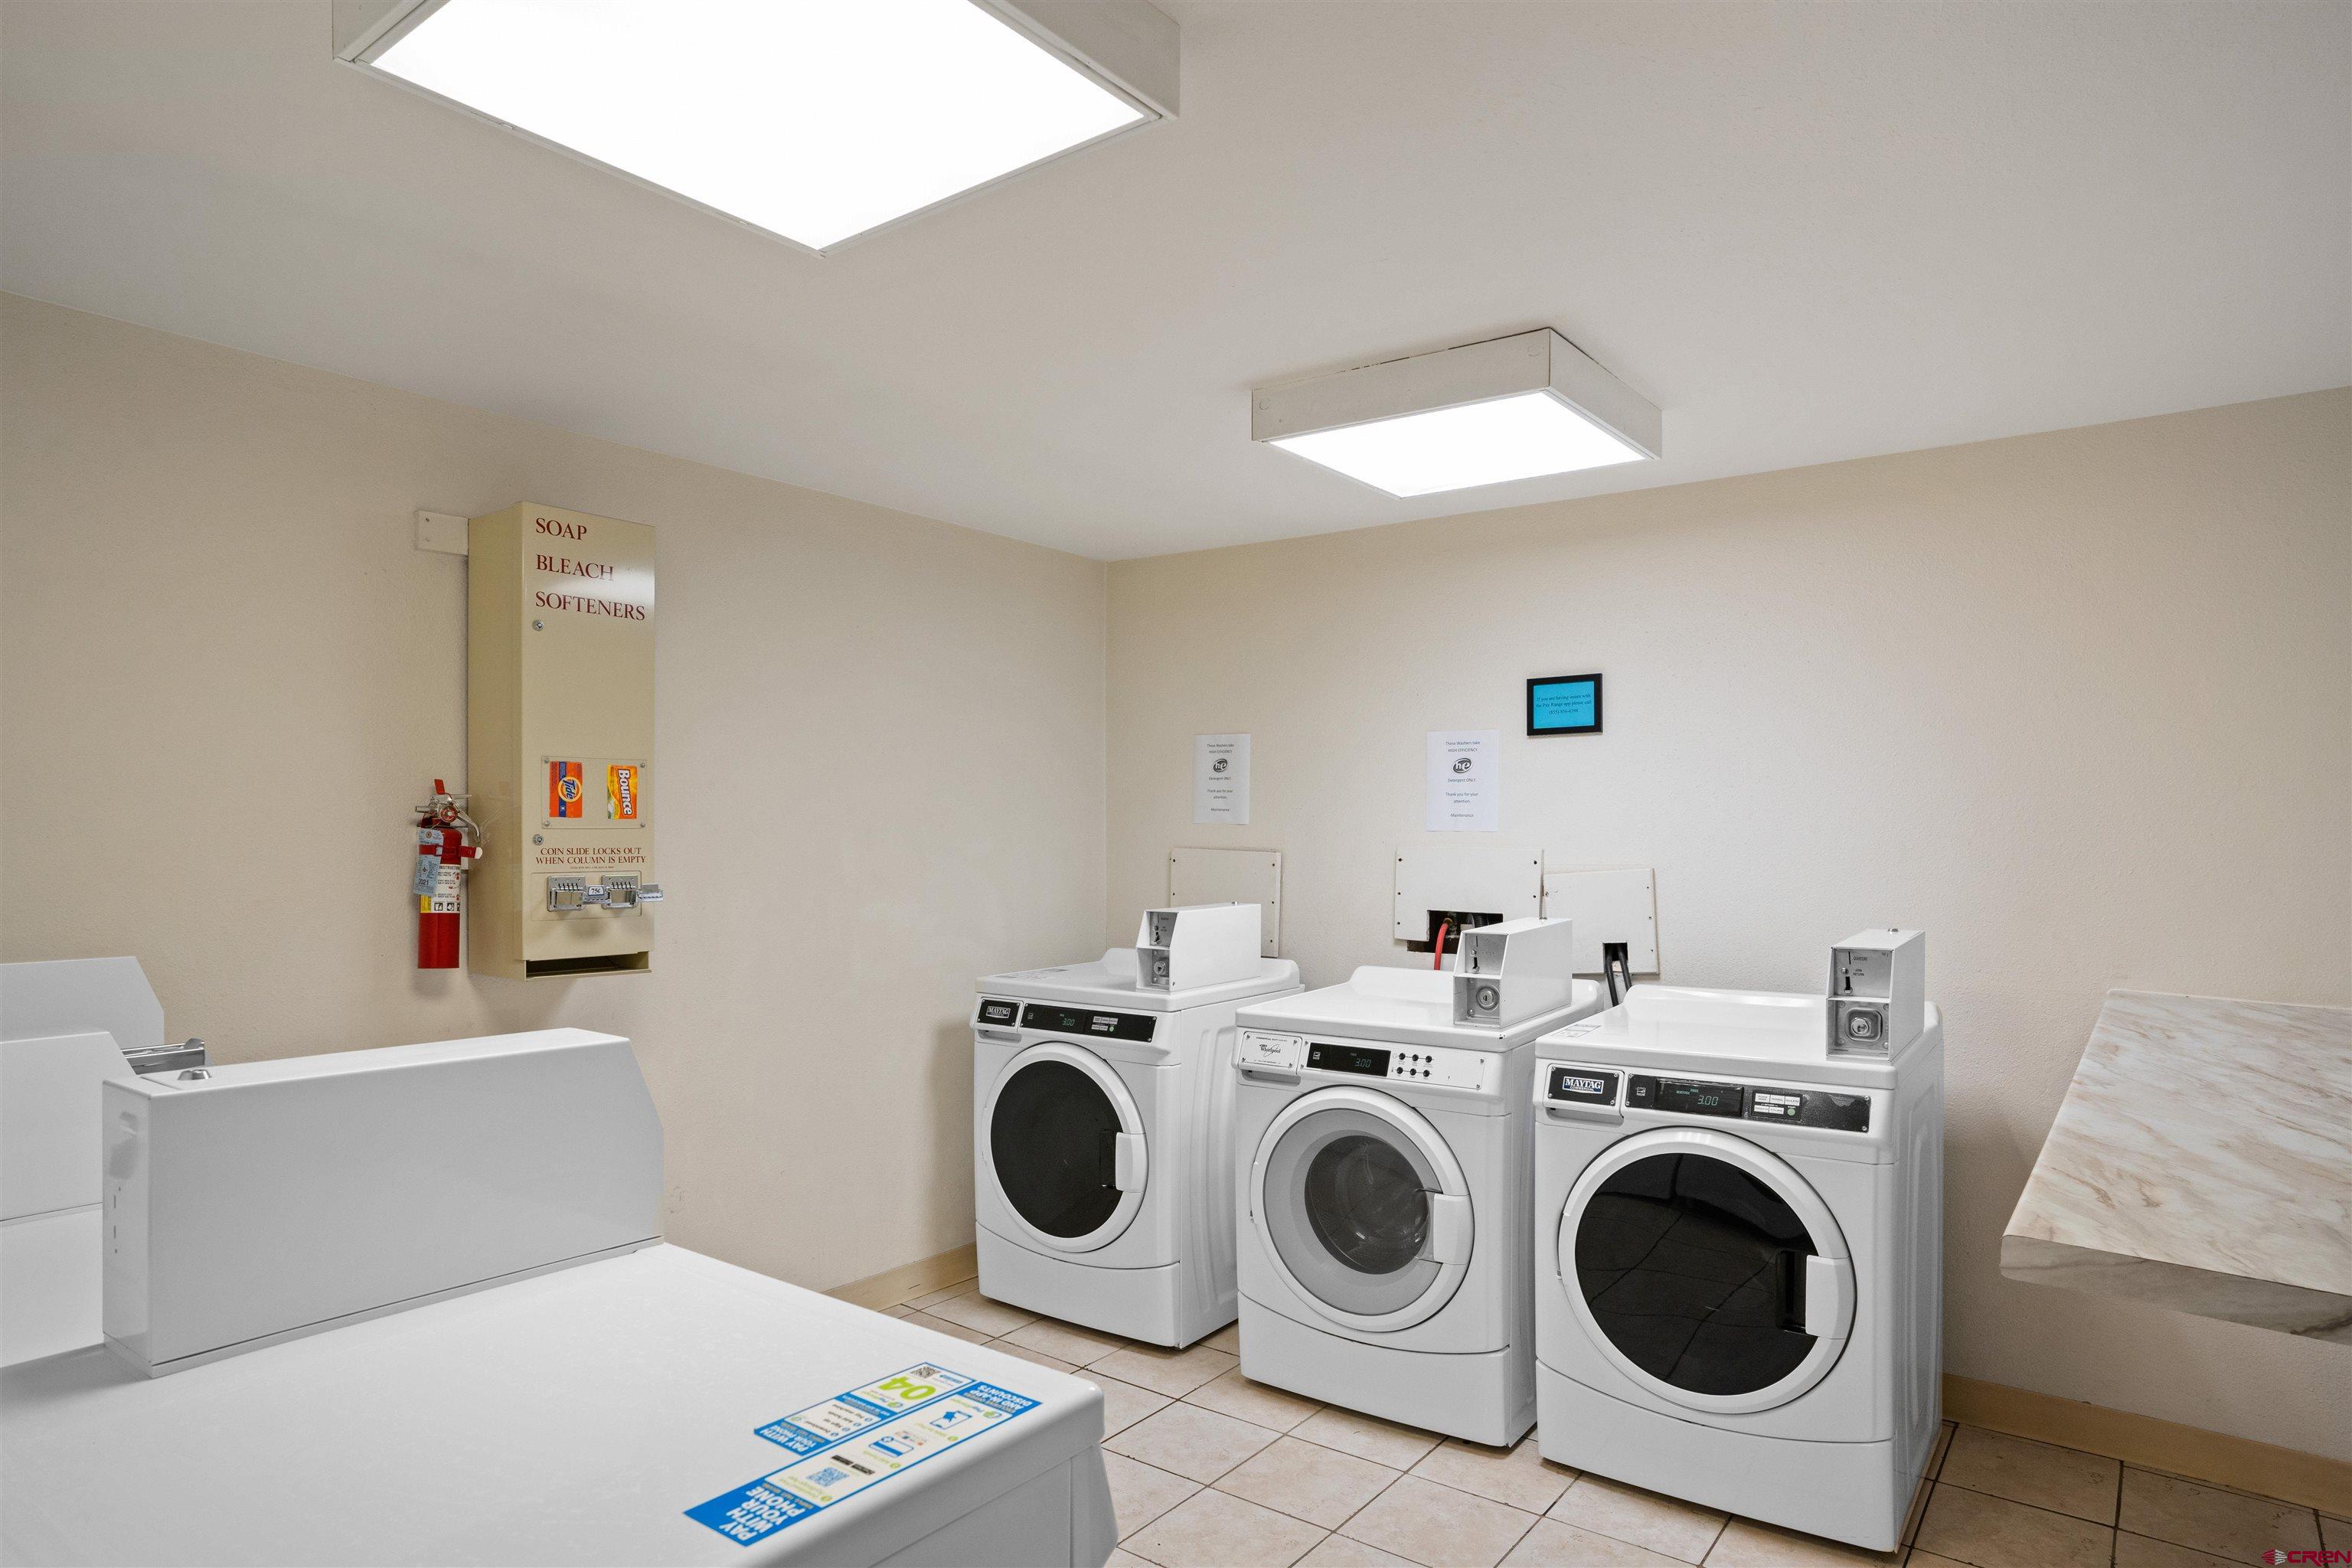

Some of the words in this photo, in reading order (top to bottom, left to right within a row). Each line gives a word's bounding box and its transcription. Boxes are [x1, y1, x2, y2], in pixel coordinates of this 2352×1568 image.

[535, 518, 587, 541] SOAP
[536, 554, 614, 581] BLEACH
[535, 591, 645, 621] SOFTENERS
[563, 779, 577, 800] Tide
[618, 768, 633, 816] Bounce
[536, 856, 564, 864] WHEN
[567, 856, 606, 864] COLUMN
[1260, 1045, 1282, 1054] Whirlpool
[1354, 1057, 1372, 1068] 3.00
[1564, 1078, 1602, 1089] MAYTAG
[1697, 1095, 1719, 1106] 3.00
[877, 1376, 937, 1400] 04
[977, 1384, 1034, 1406] DISCOUNTS
[740, 1498, 789, 1526] YOUR
[745, 1486, 806, 1517] PHONE
[718, 1521, 758, 1540] PAY
[726, 1507, 773, 1534] WITH
